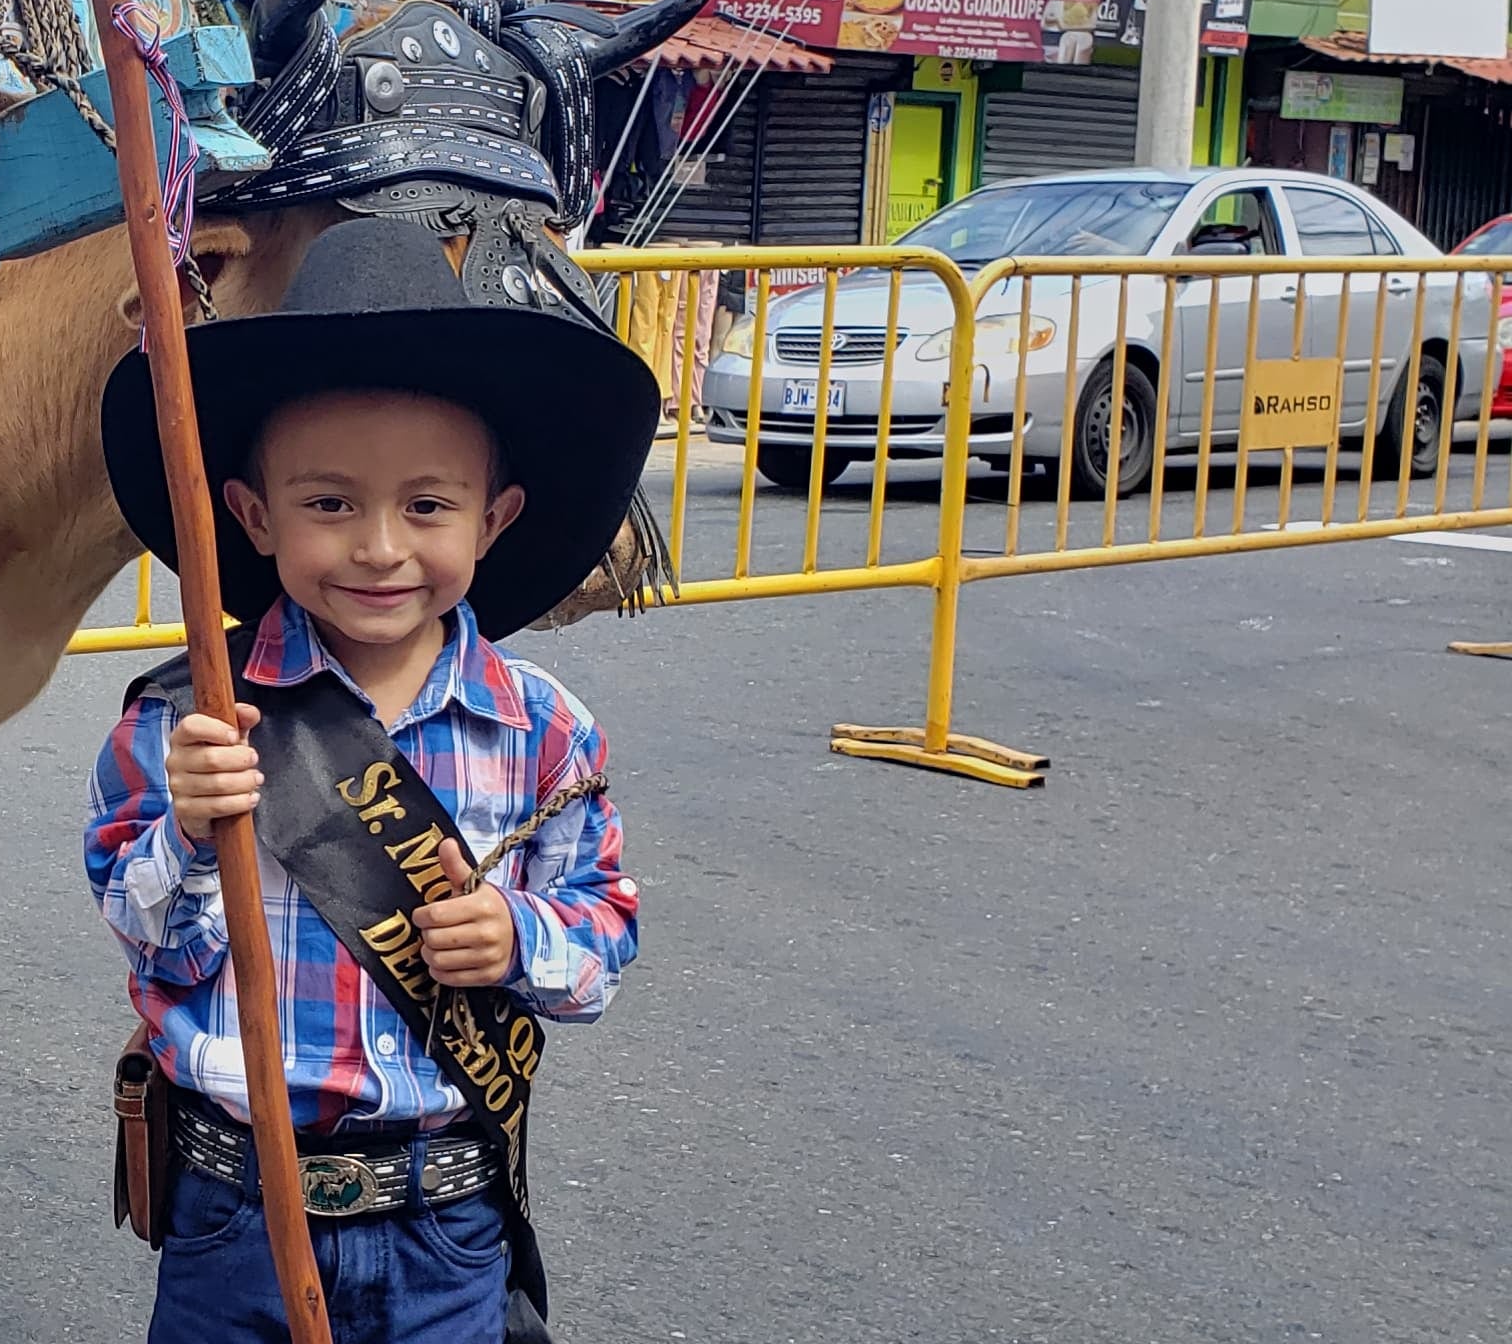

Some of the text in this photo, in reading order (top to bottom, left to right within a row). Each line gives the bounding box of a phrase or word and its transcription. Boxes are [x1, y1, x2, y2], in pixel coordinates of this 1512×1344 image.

[744, 2, 822, 25] 2234-5395
[1266, 395, 1331, 415] RAHSO
[335, 761, 406, 834] Sr.
